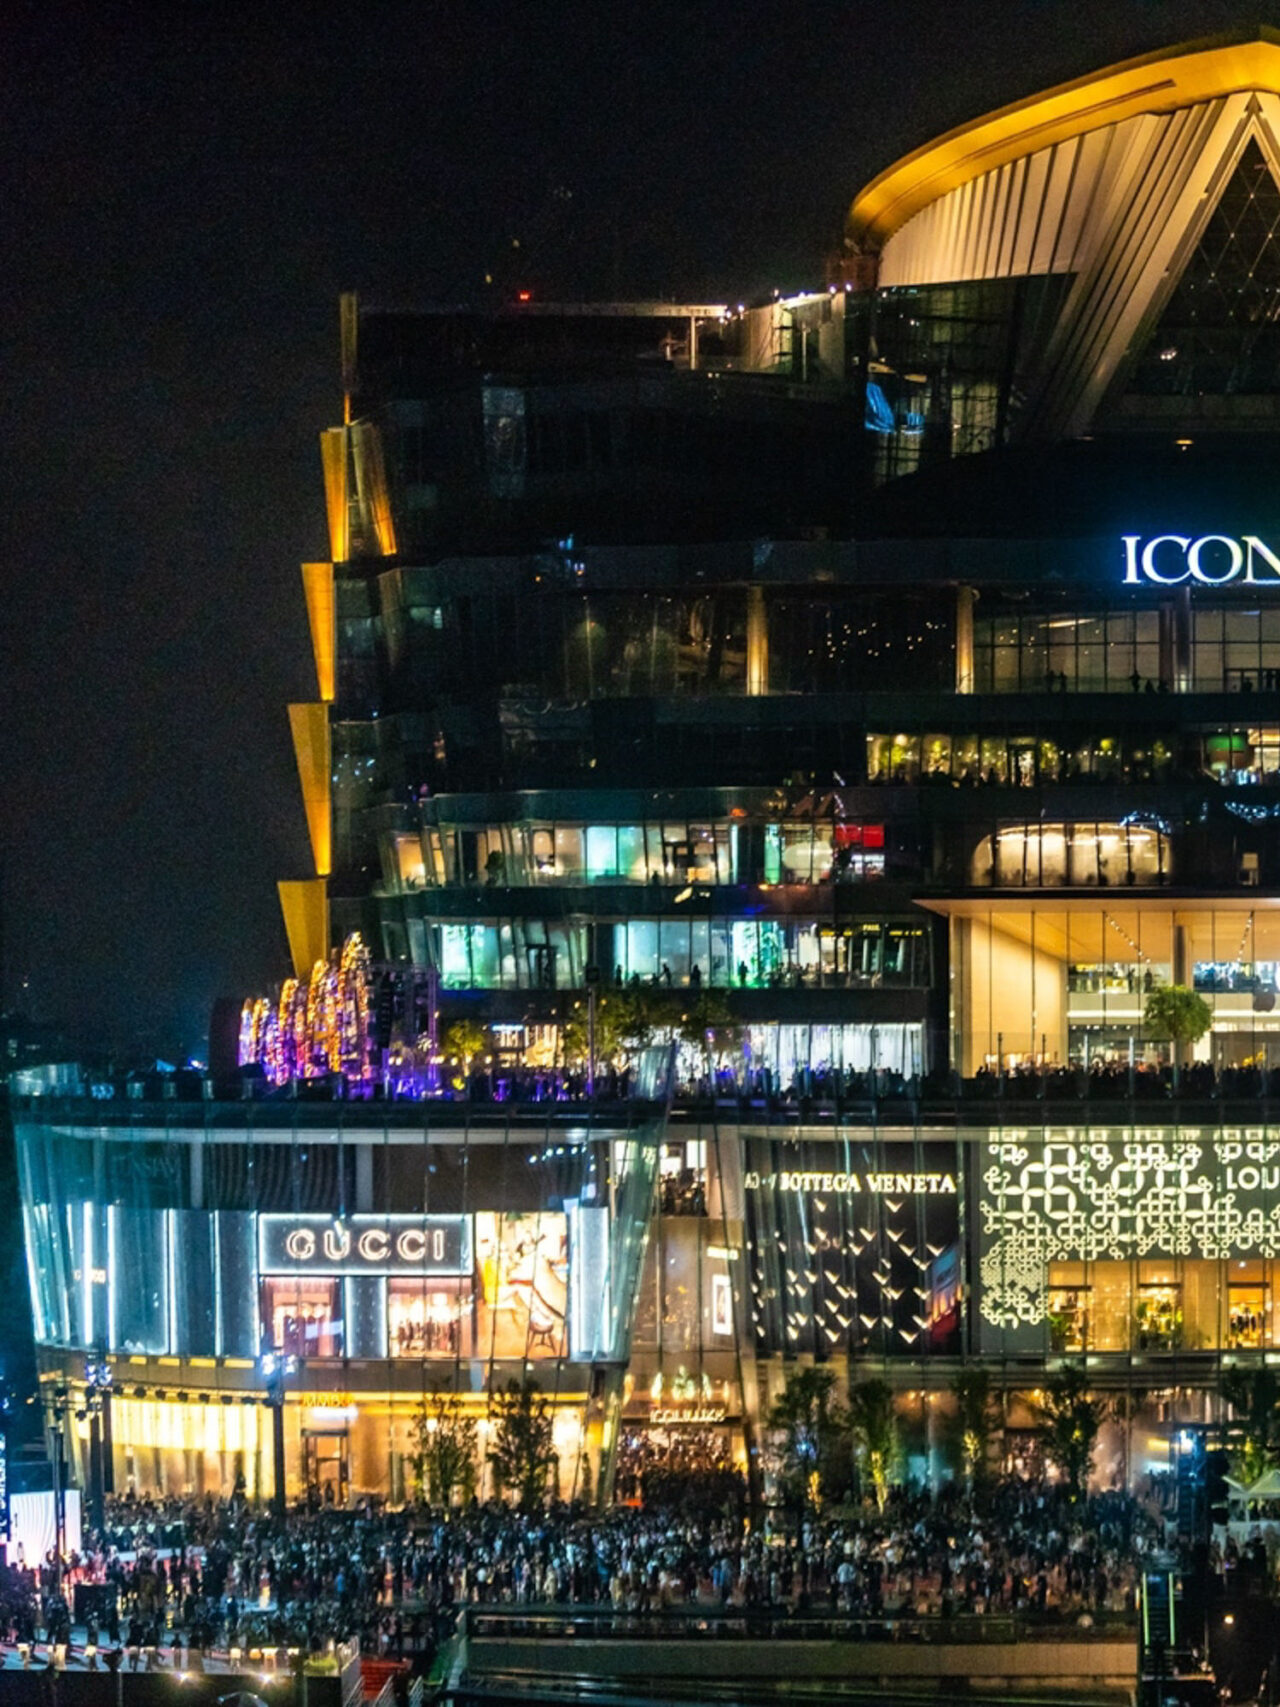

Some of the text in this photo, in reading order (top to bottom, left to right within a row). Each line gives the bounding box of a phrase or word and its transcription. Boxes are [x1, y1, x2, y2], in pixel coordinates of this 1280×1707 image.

[780, 1171, 861, 1192] BOTTEGA
[865, 1173, 957, 1194] VENETA
[286, 1228, 444, 1261] GUCCI
